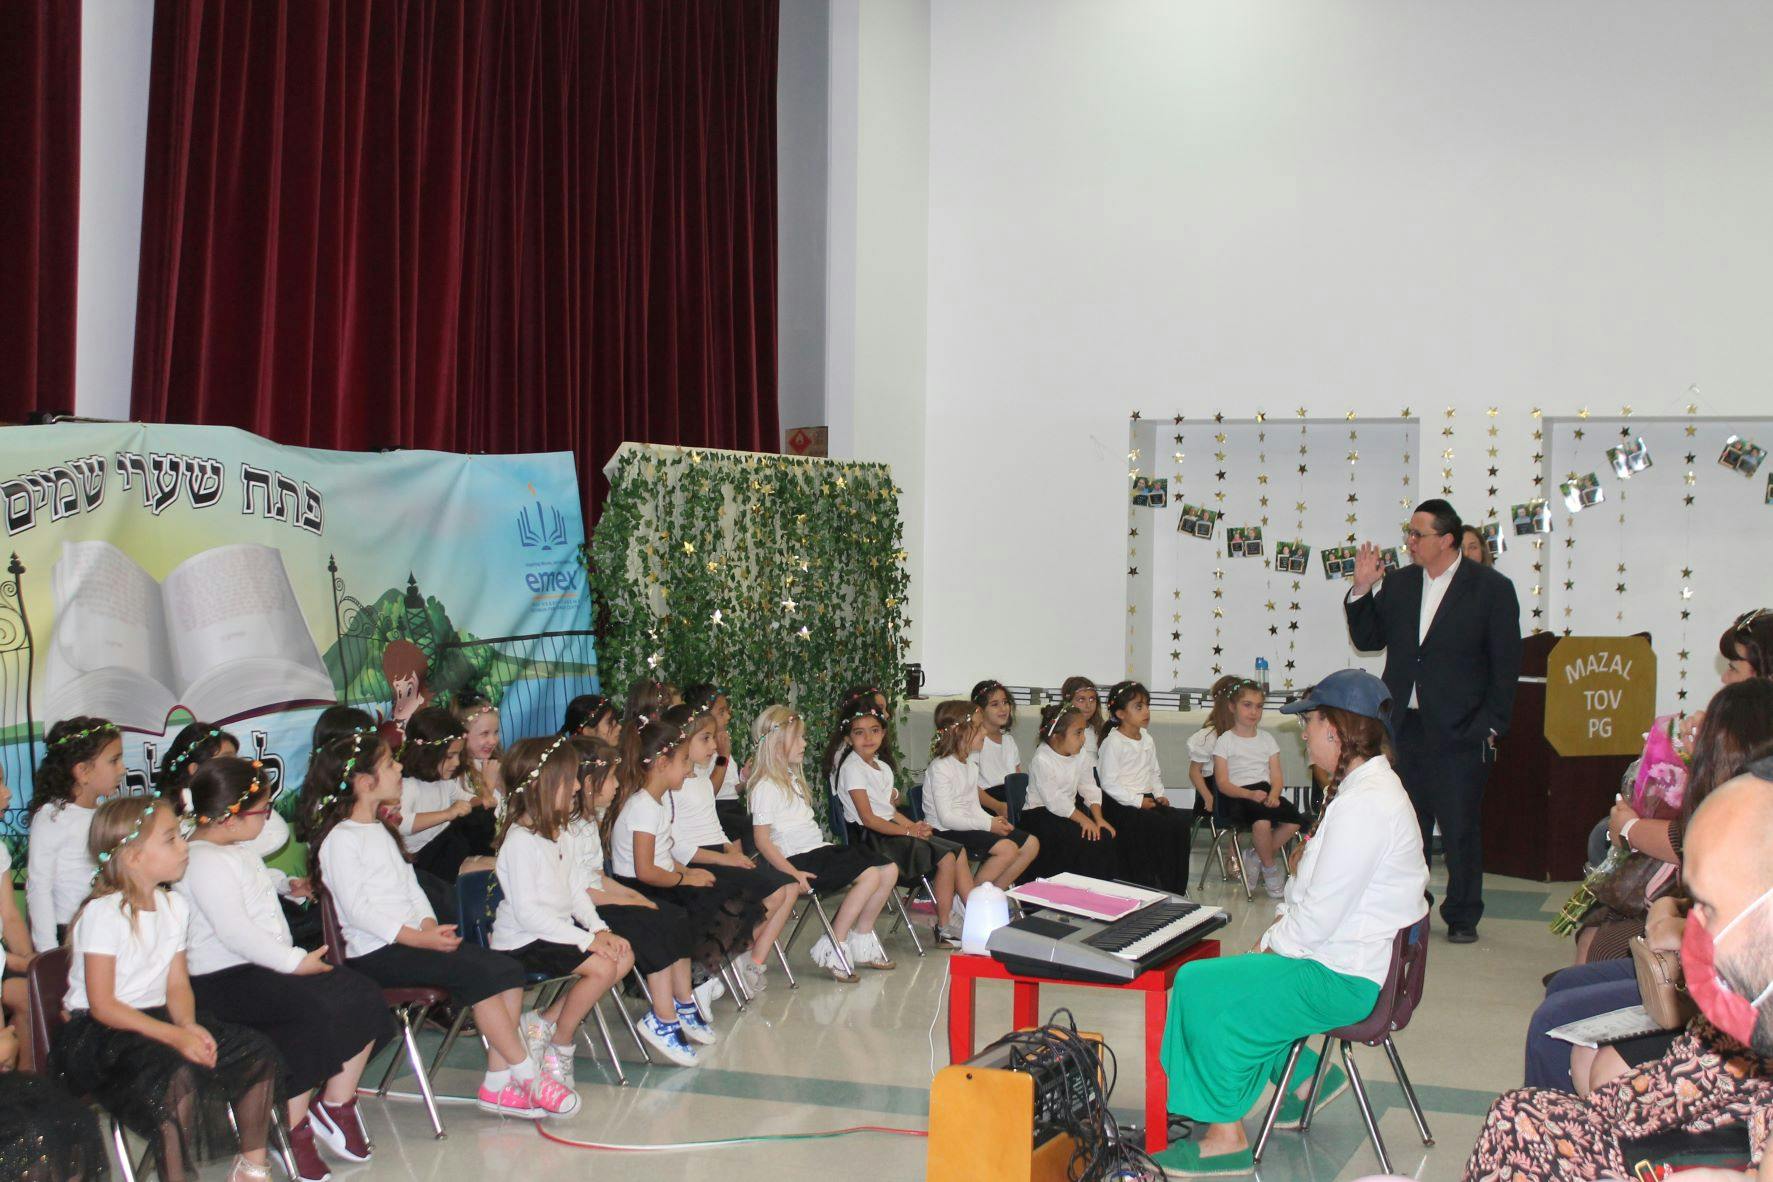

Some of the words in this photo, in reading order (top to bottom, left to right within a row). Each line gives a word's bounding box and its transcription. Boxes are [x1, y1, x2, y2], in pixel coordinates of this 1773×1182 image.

[115, 452, 225, 516] שערי
[241, 462, 324, 535] פתח
[1565, 652, 1633, 684] MAZAL
[1584, 690, 1622, 711] TOV
[1588, 718, 1612, 738] PG
